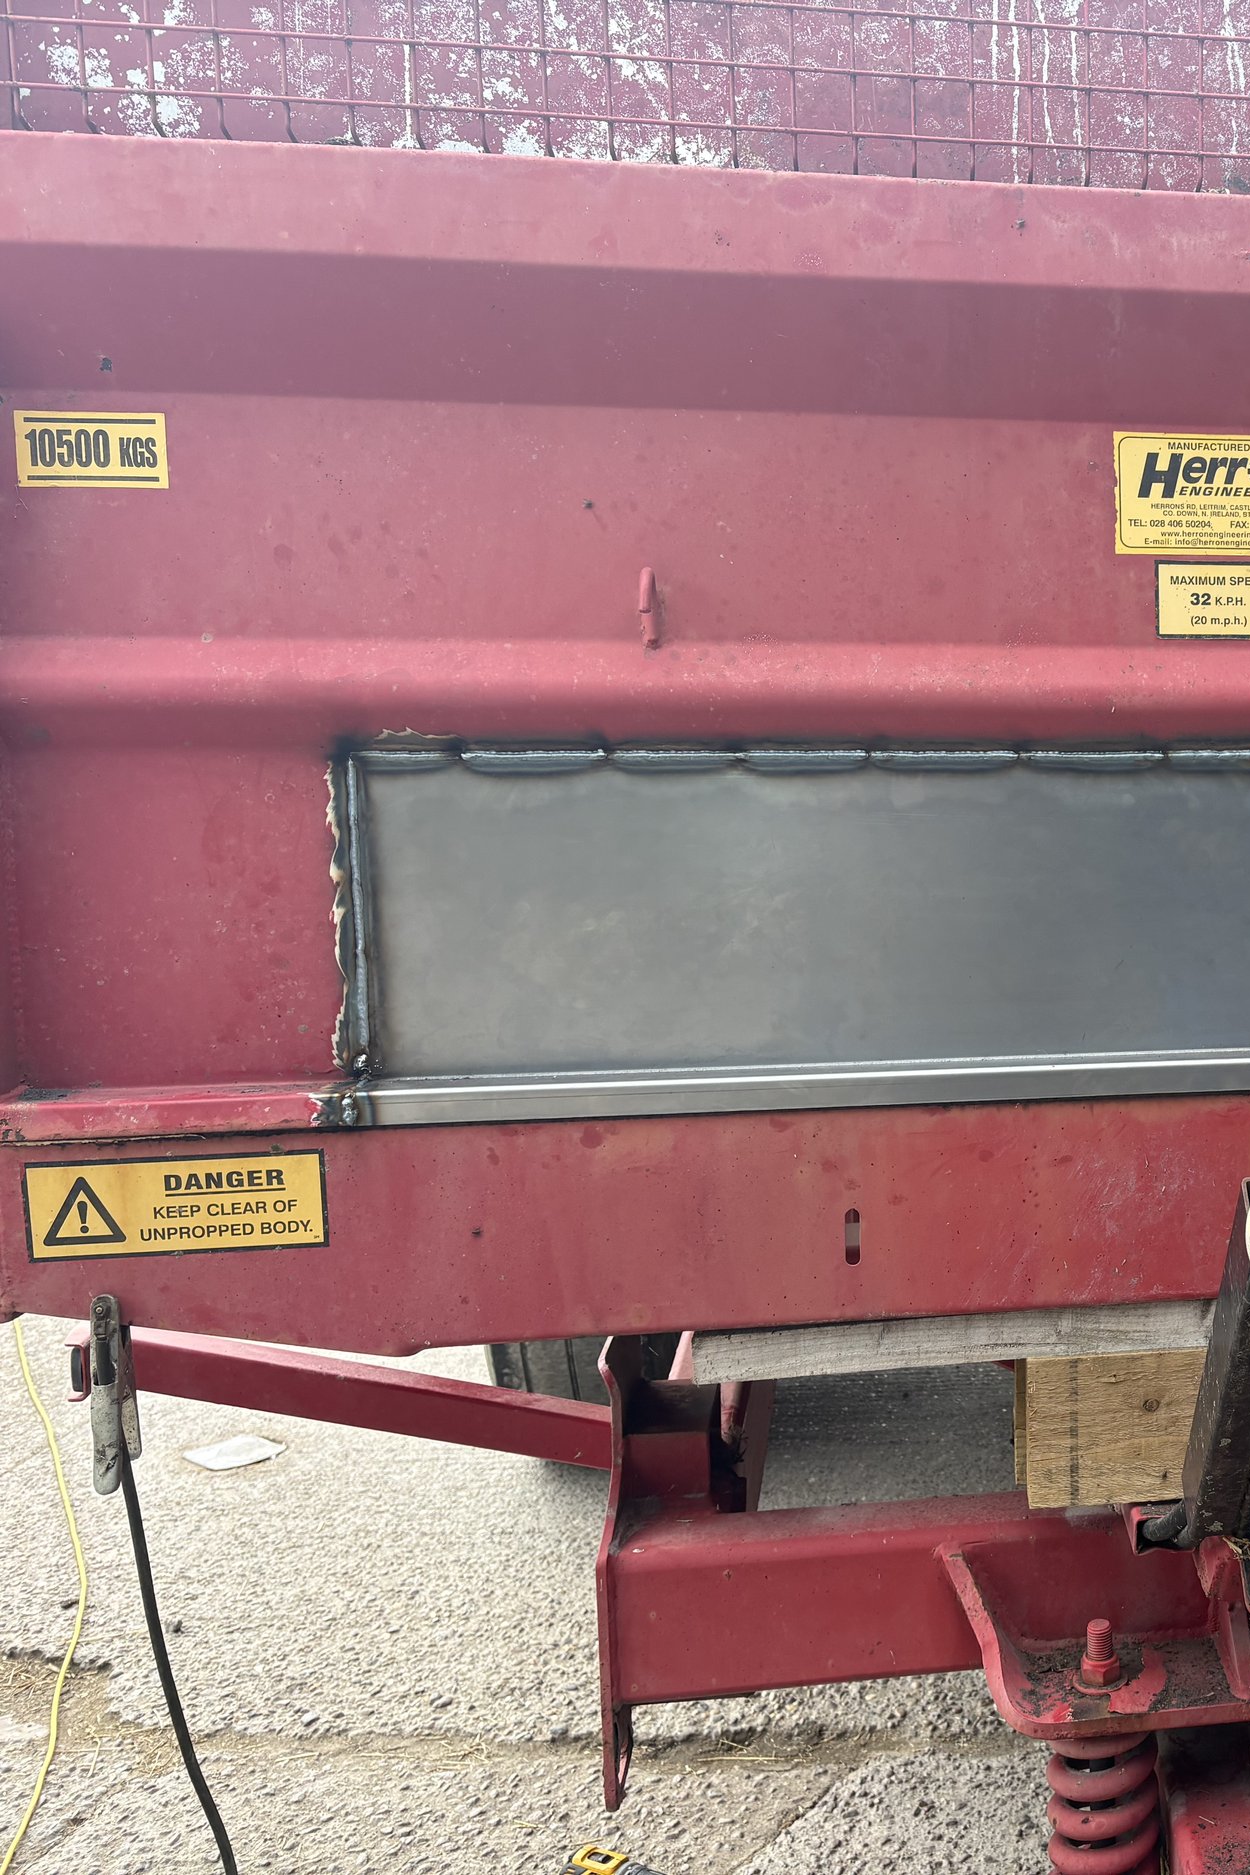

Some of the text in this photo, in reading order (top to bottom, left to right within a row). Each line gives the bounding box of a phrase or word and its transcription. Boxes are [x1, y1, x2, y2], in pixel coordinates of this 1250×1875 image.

[24, 428, 158, 468] 10500 KGS
[1167, 442, 1250, 452] MANUFACTURED
[1128, 519, 1148, 528] TEL:
[1149, 519, 1166, 528] 028
[1167, 519, 1184, 528] 406
[1230, 521, 1250, 529] FAX:
[1144, 538, 1173, 546] E-mail:
[1170, 575, 1226, 586] MAXIMUM
[1190, 592, 1247, 606] 32 K.P.H.
[1190, 615, 1248, 628] (20 m.p.h.)
[163, 1168, 286, 1192] DANGER
[153, 1199, 298, 1220] KEEP CLEAR OF
[139, 1219, 314, 1242] UNPROPPED BODY.
